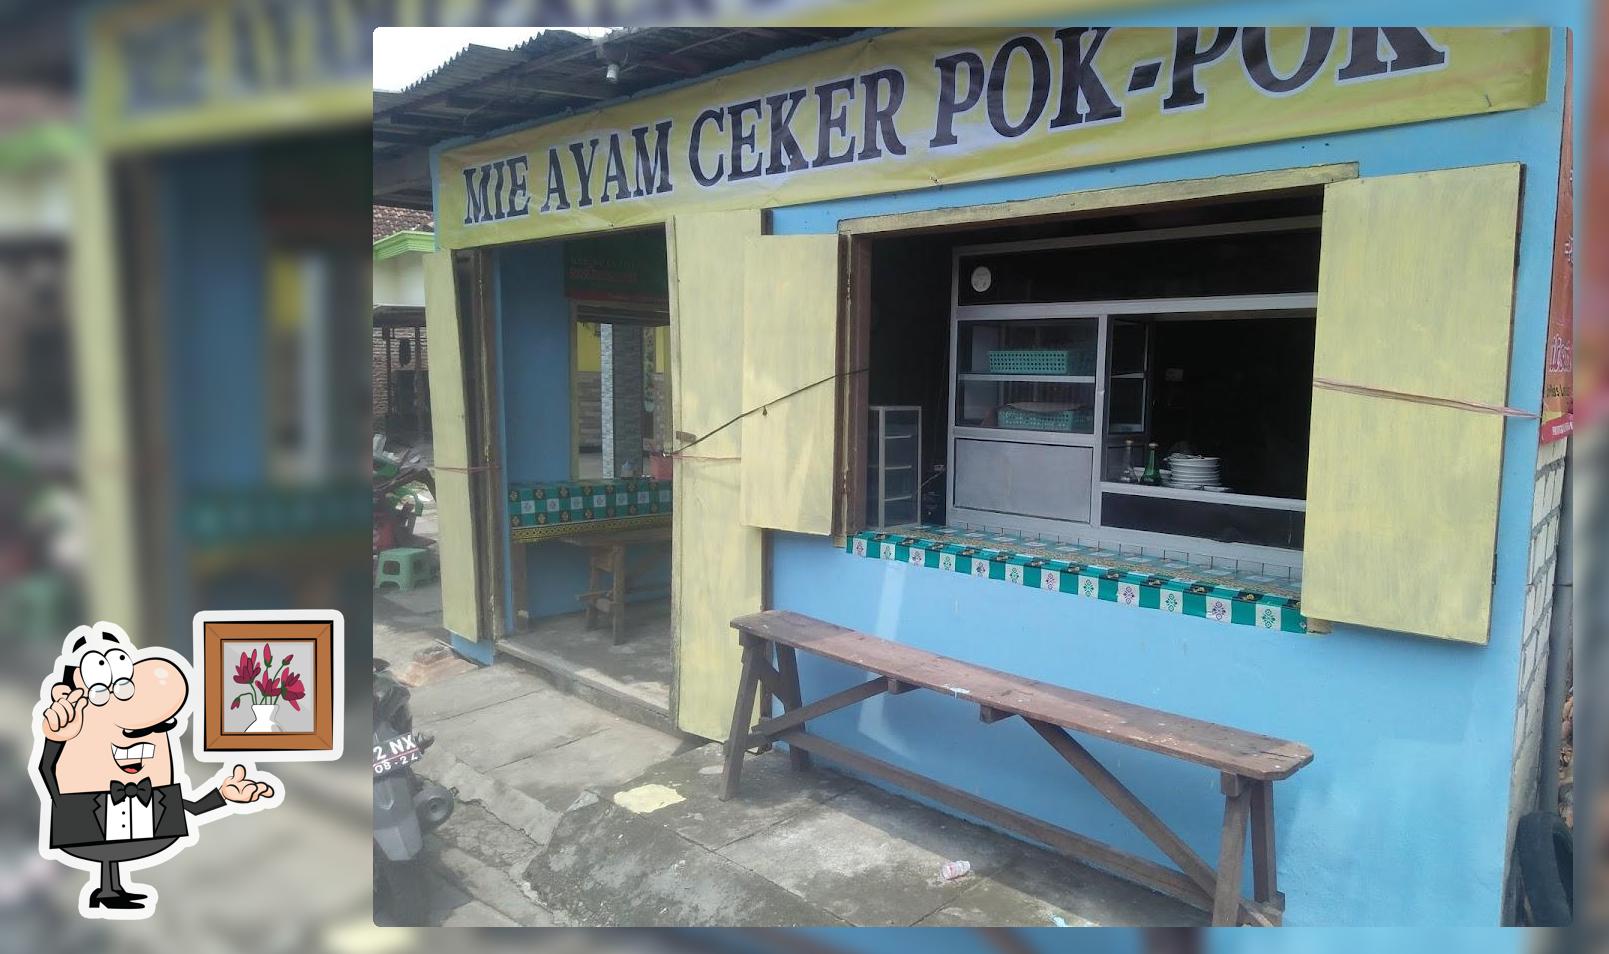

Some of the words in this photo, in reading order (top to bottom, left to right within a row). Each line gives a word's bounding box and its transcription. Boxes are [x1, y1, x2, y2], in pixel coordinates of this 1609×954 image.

[463, 154, 531, 225] MIE
[541, 119, 674, 213] AYAM
[688, 68, 907, 187] CEKER
[389, 734, 416, 755] NX
